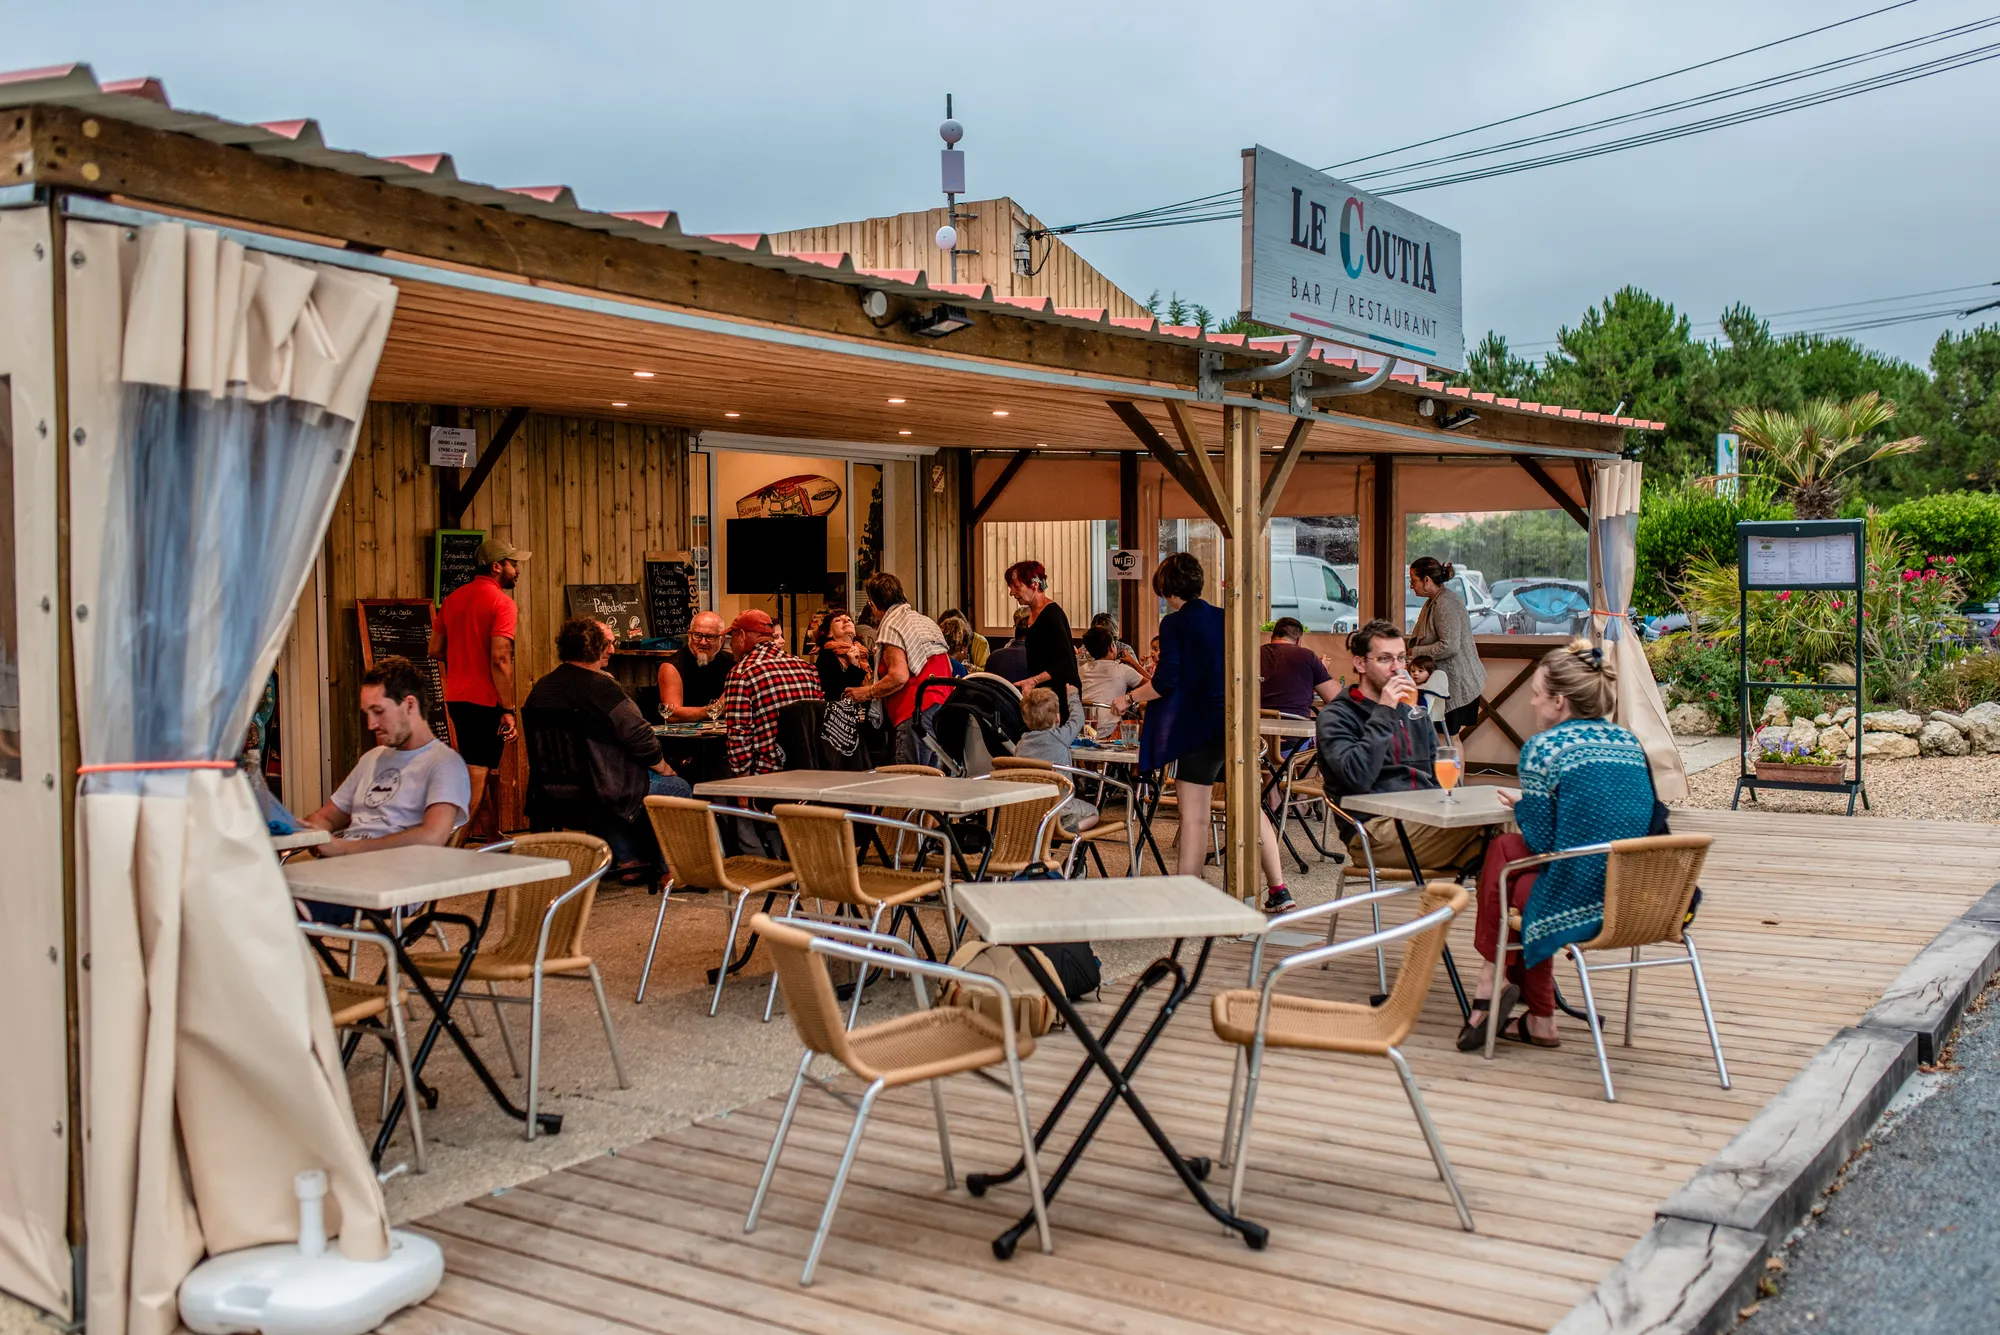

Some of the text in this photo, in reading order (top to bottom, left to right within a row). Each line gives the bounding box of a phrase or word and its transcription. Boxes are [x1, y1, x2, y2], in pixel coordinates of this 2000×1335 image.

[1290, 186, 1437, 294] LE COUTIA
[1291, 276, 1437, 339] BAR / RESTAURANT
[829, 713, 857, 735] WHISKEY
